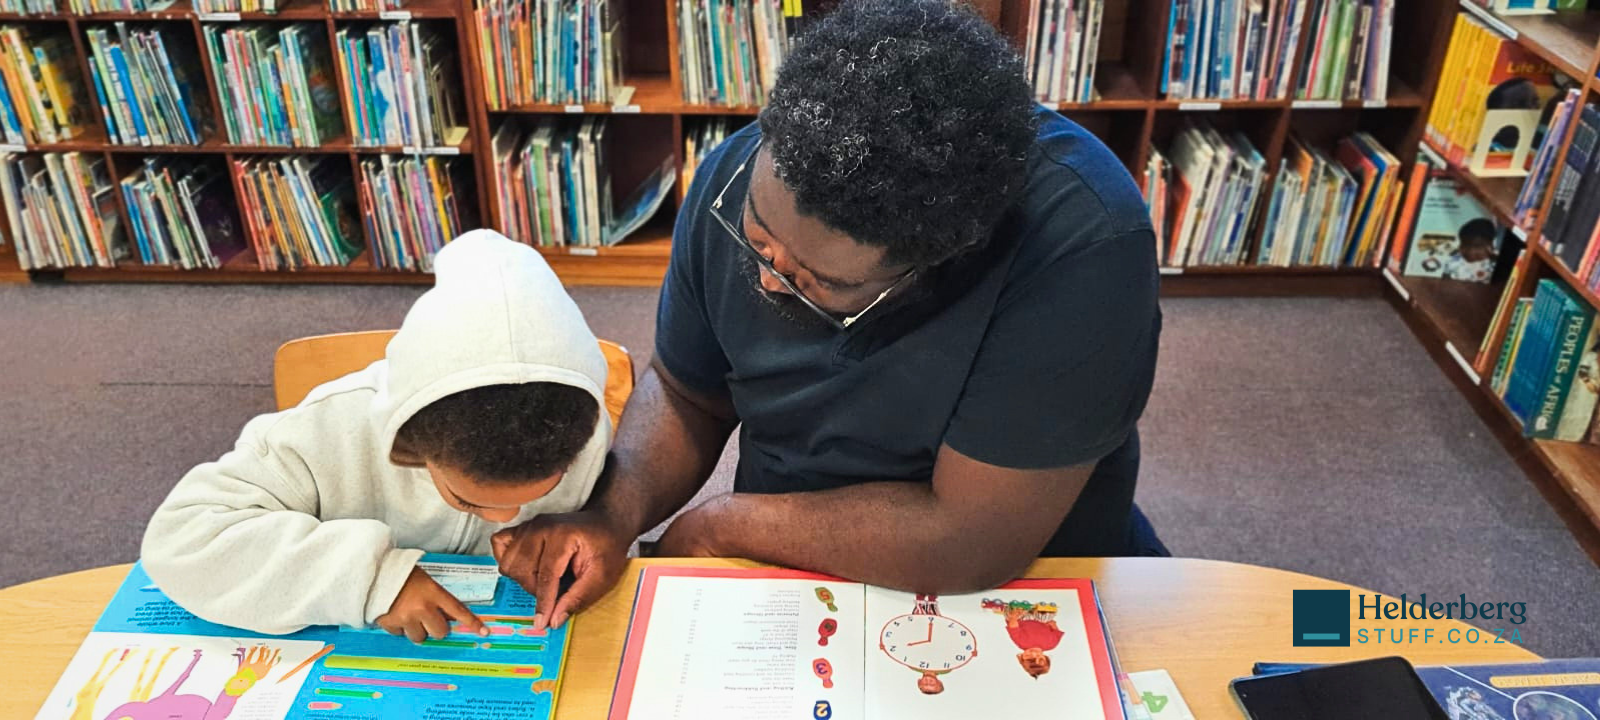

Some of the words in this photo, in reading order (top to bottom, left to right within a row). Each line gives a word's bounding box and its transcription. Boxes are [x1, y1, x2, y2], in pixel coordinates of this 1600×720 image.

[1555, 315, 1585, 374] PEOPLES
[815, 662, 828, 675] 3
[816, 703, 828, 717] 2
